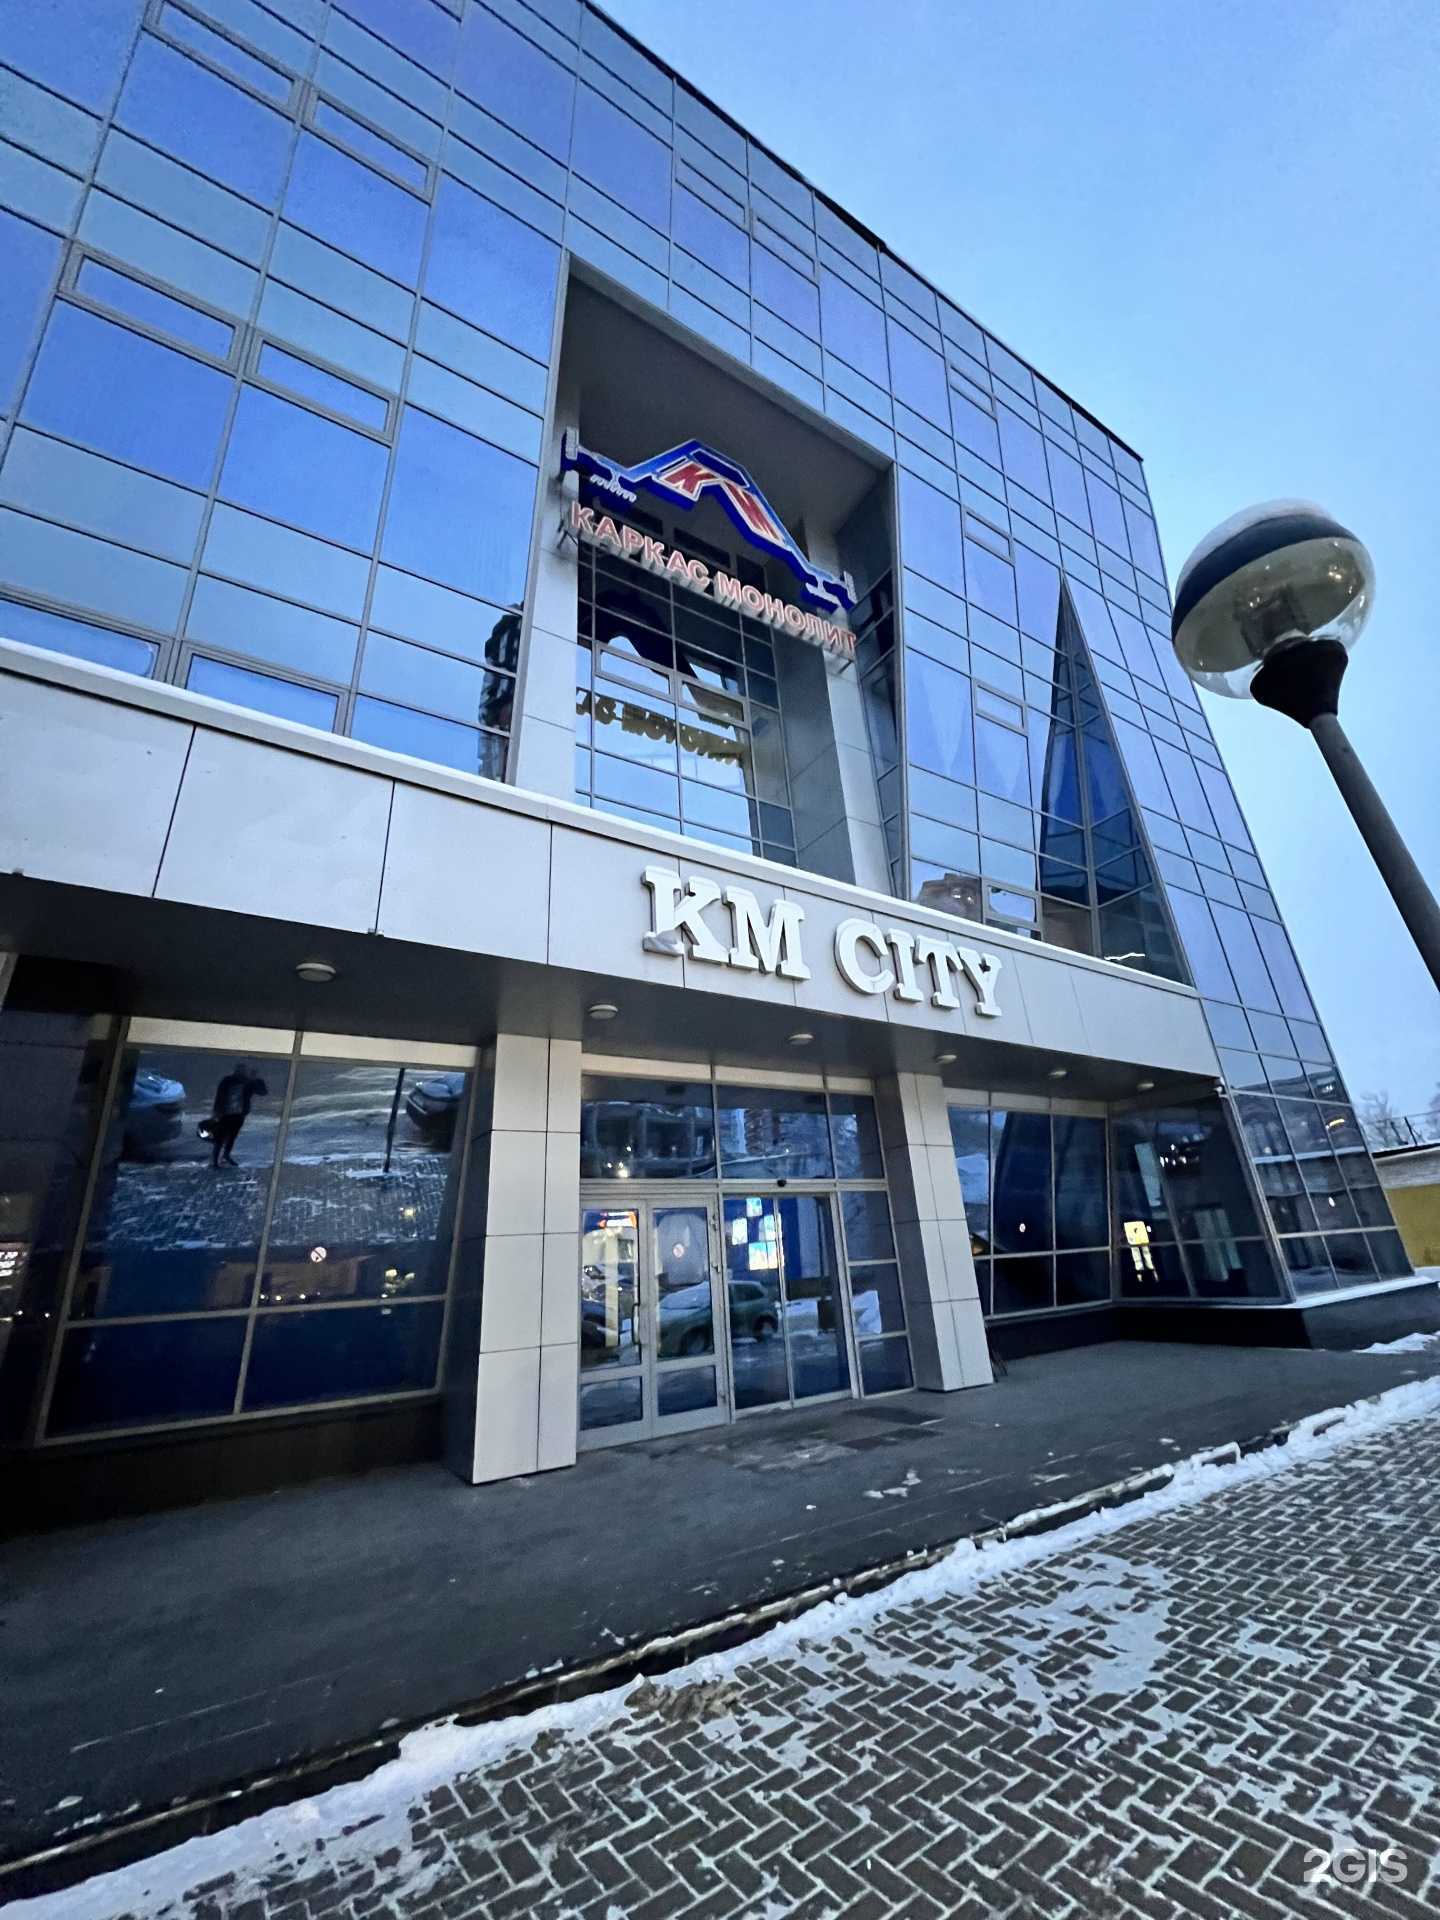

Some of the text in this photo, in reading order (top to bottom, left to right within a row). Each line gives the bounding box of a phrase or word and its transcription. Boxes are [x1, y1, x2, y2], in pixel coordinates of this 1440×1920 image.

[571, 500, 857, 659] КАРКАС МОНОЛИТ
[641, 865, 1002, 1017] KM CITY
